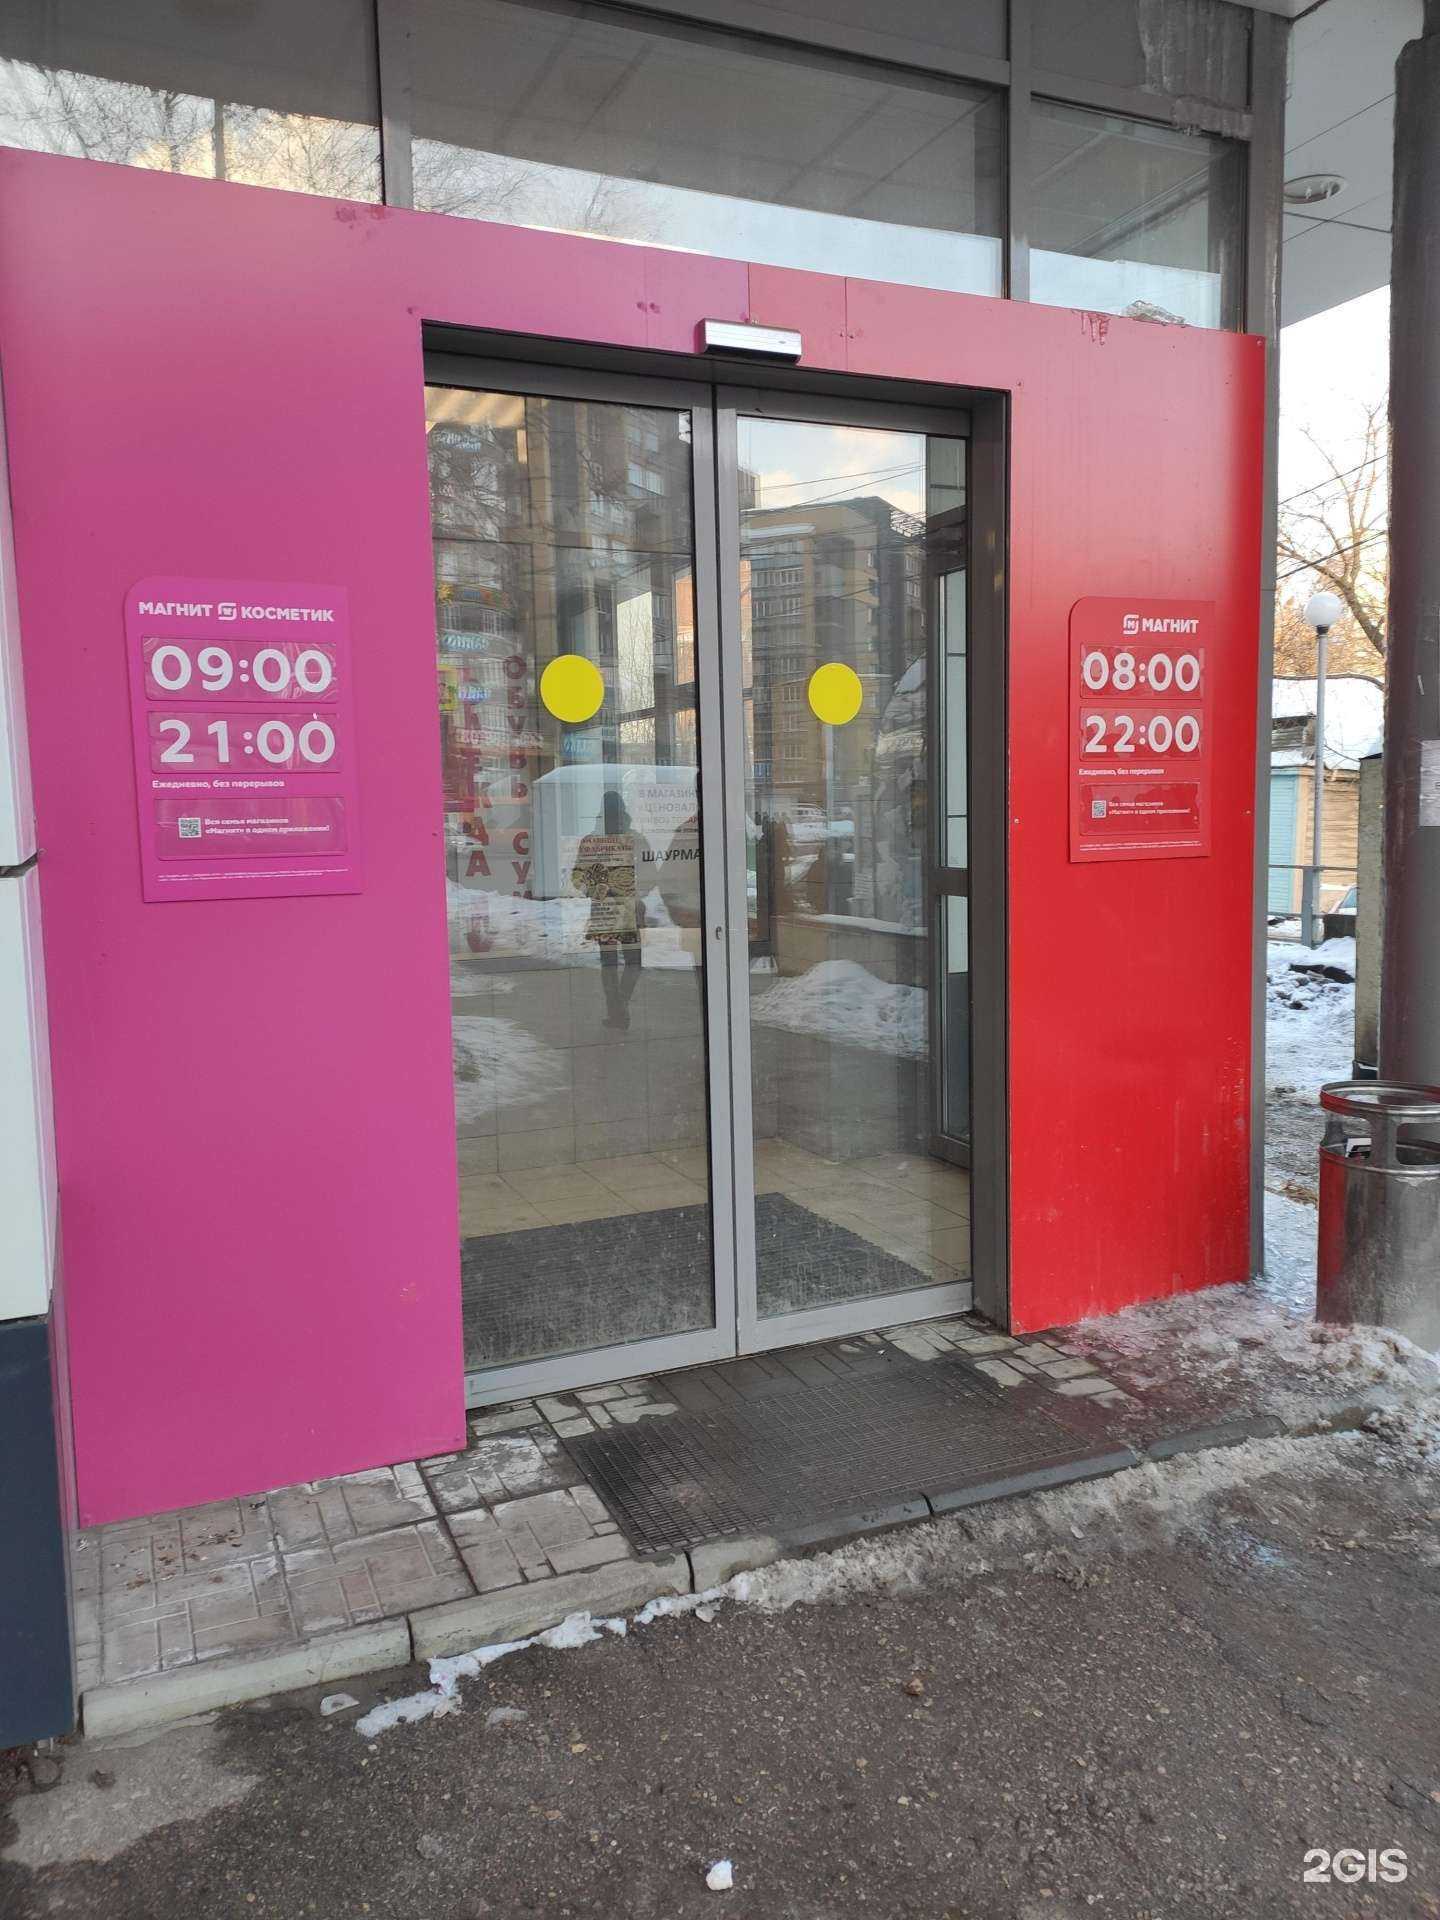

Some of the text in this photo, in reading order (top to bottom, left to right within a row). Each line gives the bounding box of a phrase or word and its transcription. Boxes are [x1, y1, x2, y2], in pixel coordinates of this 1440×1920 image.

[138, 602, 335, 622] МАГНИТ КОСМЕТИК
[1142, 618, 1200, 633] МАГНИТ
[150, 645, 333, 694] 09:00
[1082, 651, 1201, 692] 08:00
[158, 718, 337, 764] 21:00
[1084, 714, 1201, 753] 22:00
[152, 779, 211, 790] Ежедневно,
[212, 779, 230, 788] без
[641, 848, 702, 863] ШАУРМА
